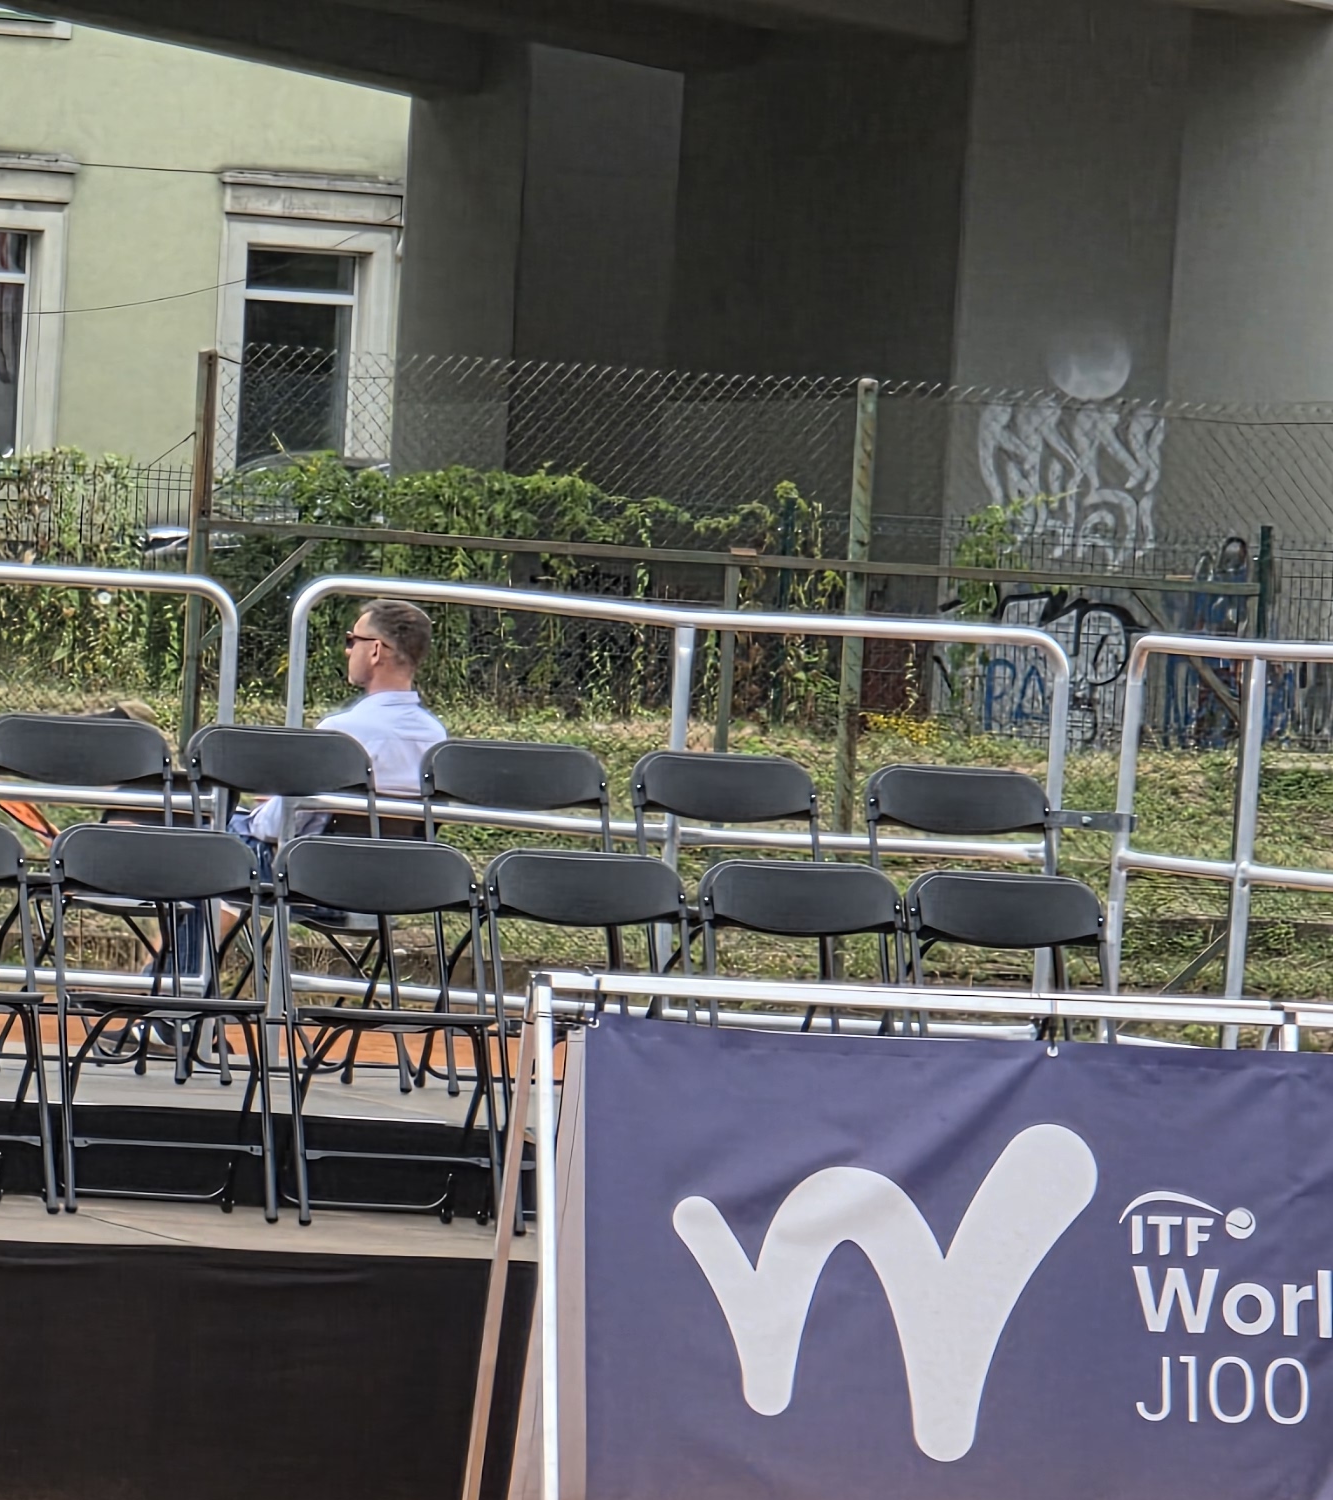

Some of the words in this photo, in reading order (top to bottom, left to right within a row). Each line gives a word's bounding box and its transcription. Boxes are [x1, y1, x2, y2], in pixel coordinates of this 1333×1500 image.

[1131, 1214, 1215, 1257] ITF
[1132, 1265, 1333, 1339] Worl
[1135, 1355, 1309, 1425] J100
